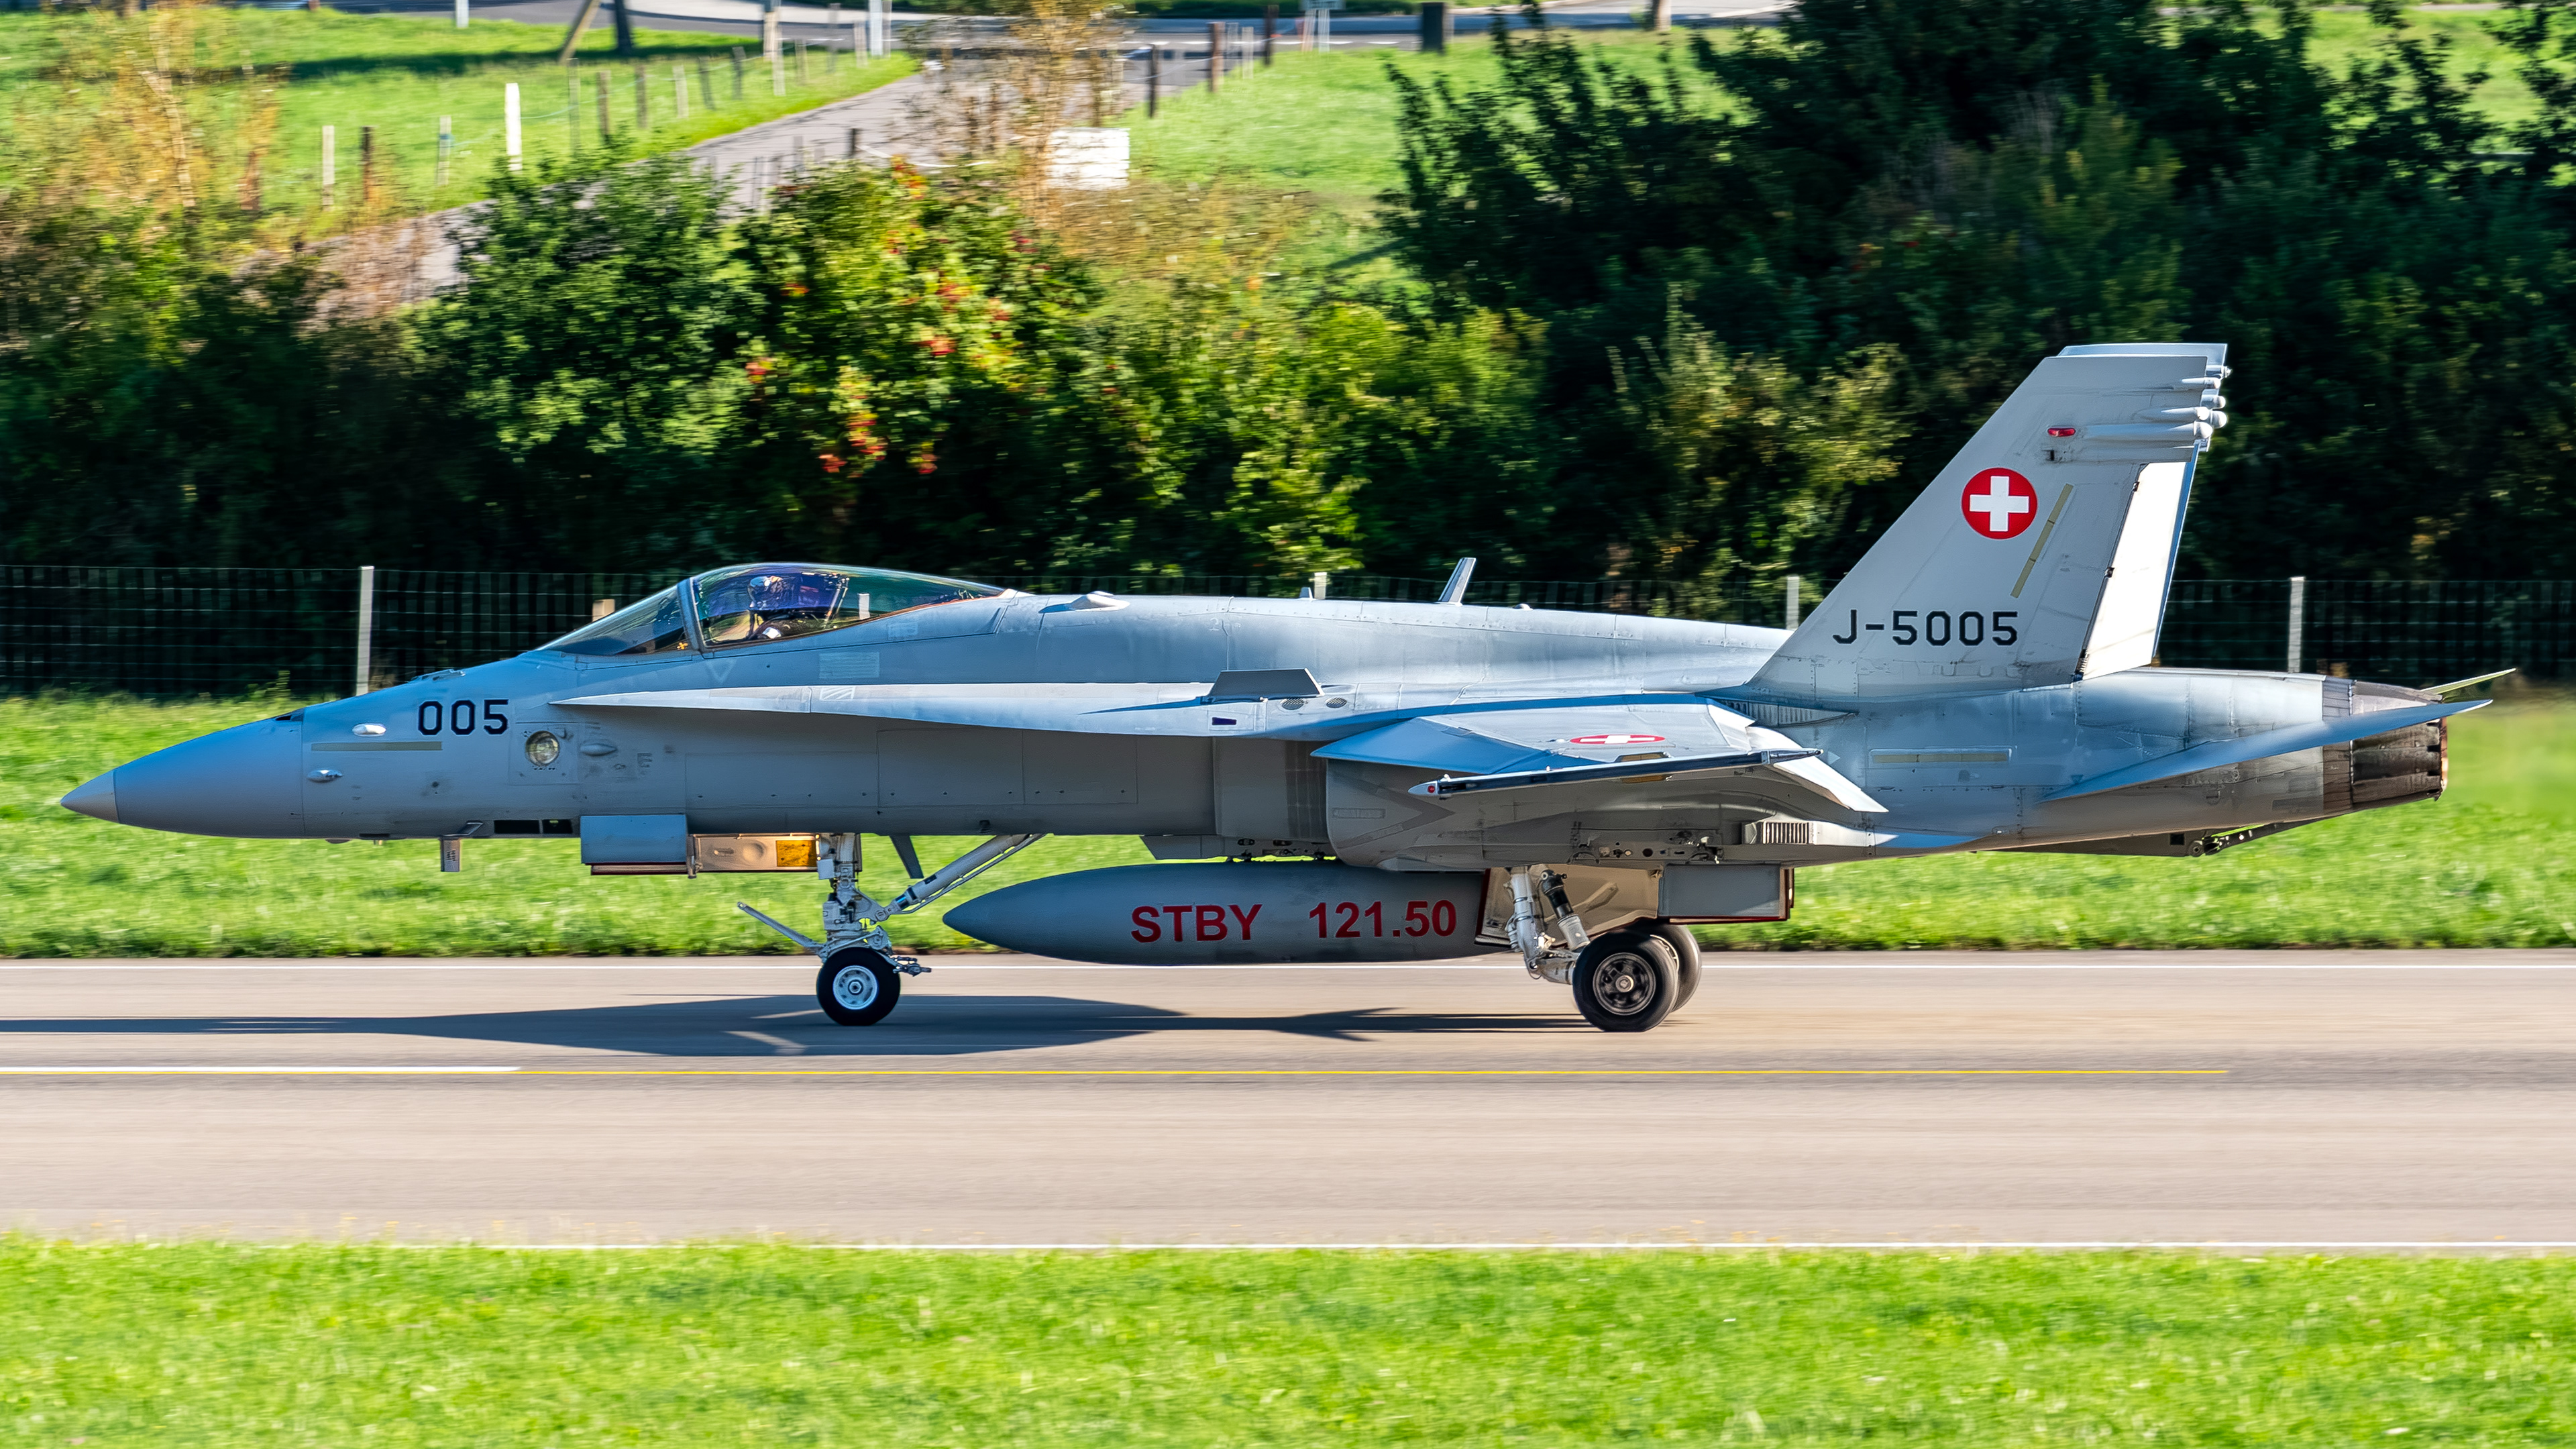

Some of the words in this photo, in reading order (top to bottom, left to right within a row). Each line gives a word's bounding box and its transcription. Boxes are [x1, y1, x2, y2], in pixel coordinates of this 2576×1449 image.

[1831, 608, 2019, 647] J-5005
[417, 698, 510, 737] 005
[1130, 904, 1263, 943] STBY
[1309, 900, 1457, 938] 121.50
